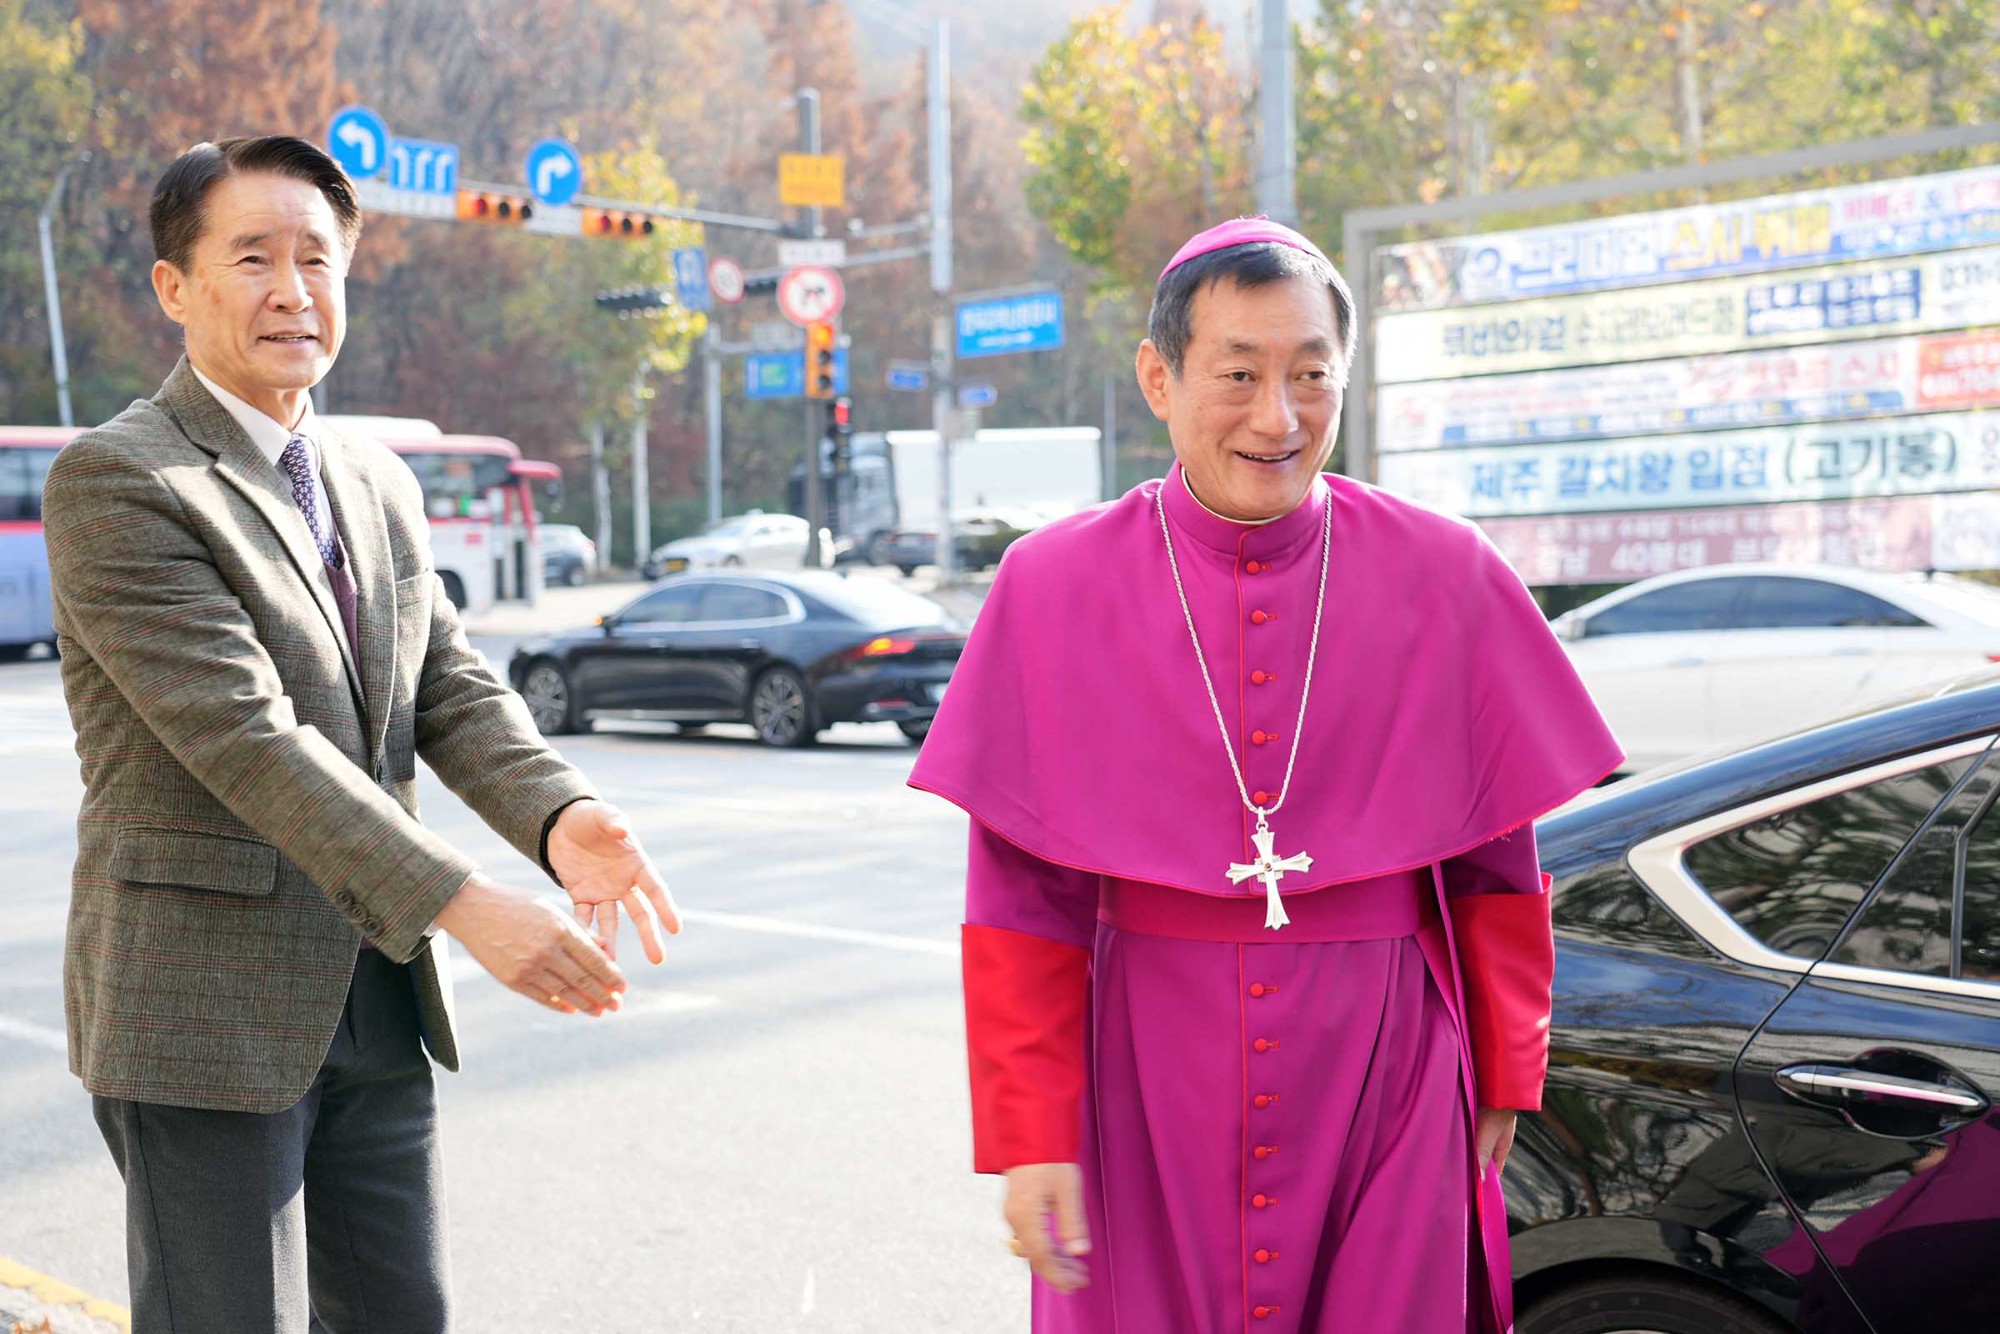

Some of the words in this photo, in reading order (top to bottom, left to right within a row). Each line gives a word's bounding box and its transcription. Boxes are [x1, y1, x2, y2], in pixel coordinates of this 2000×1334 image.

[1471, 458, 1541, 500] 제주
[1558, 451, 1674, 497] 갈치왕
[1688, 446, 1767, 490] 입점
